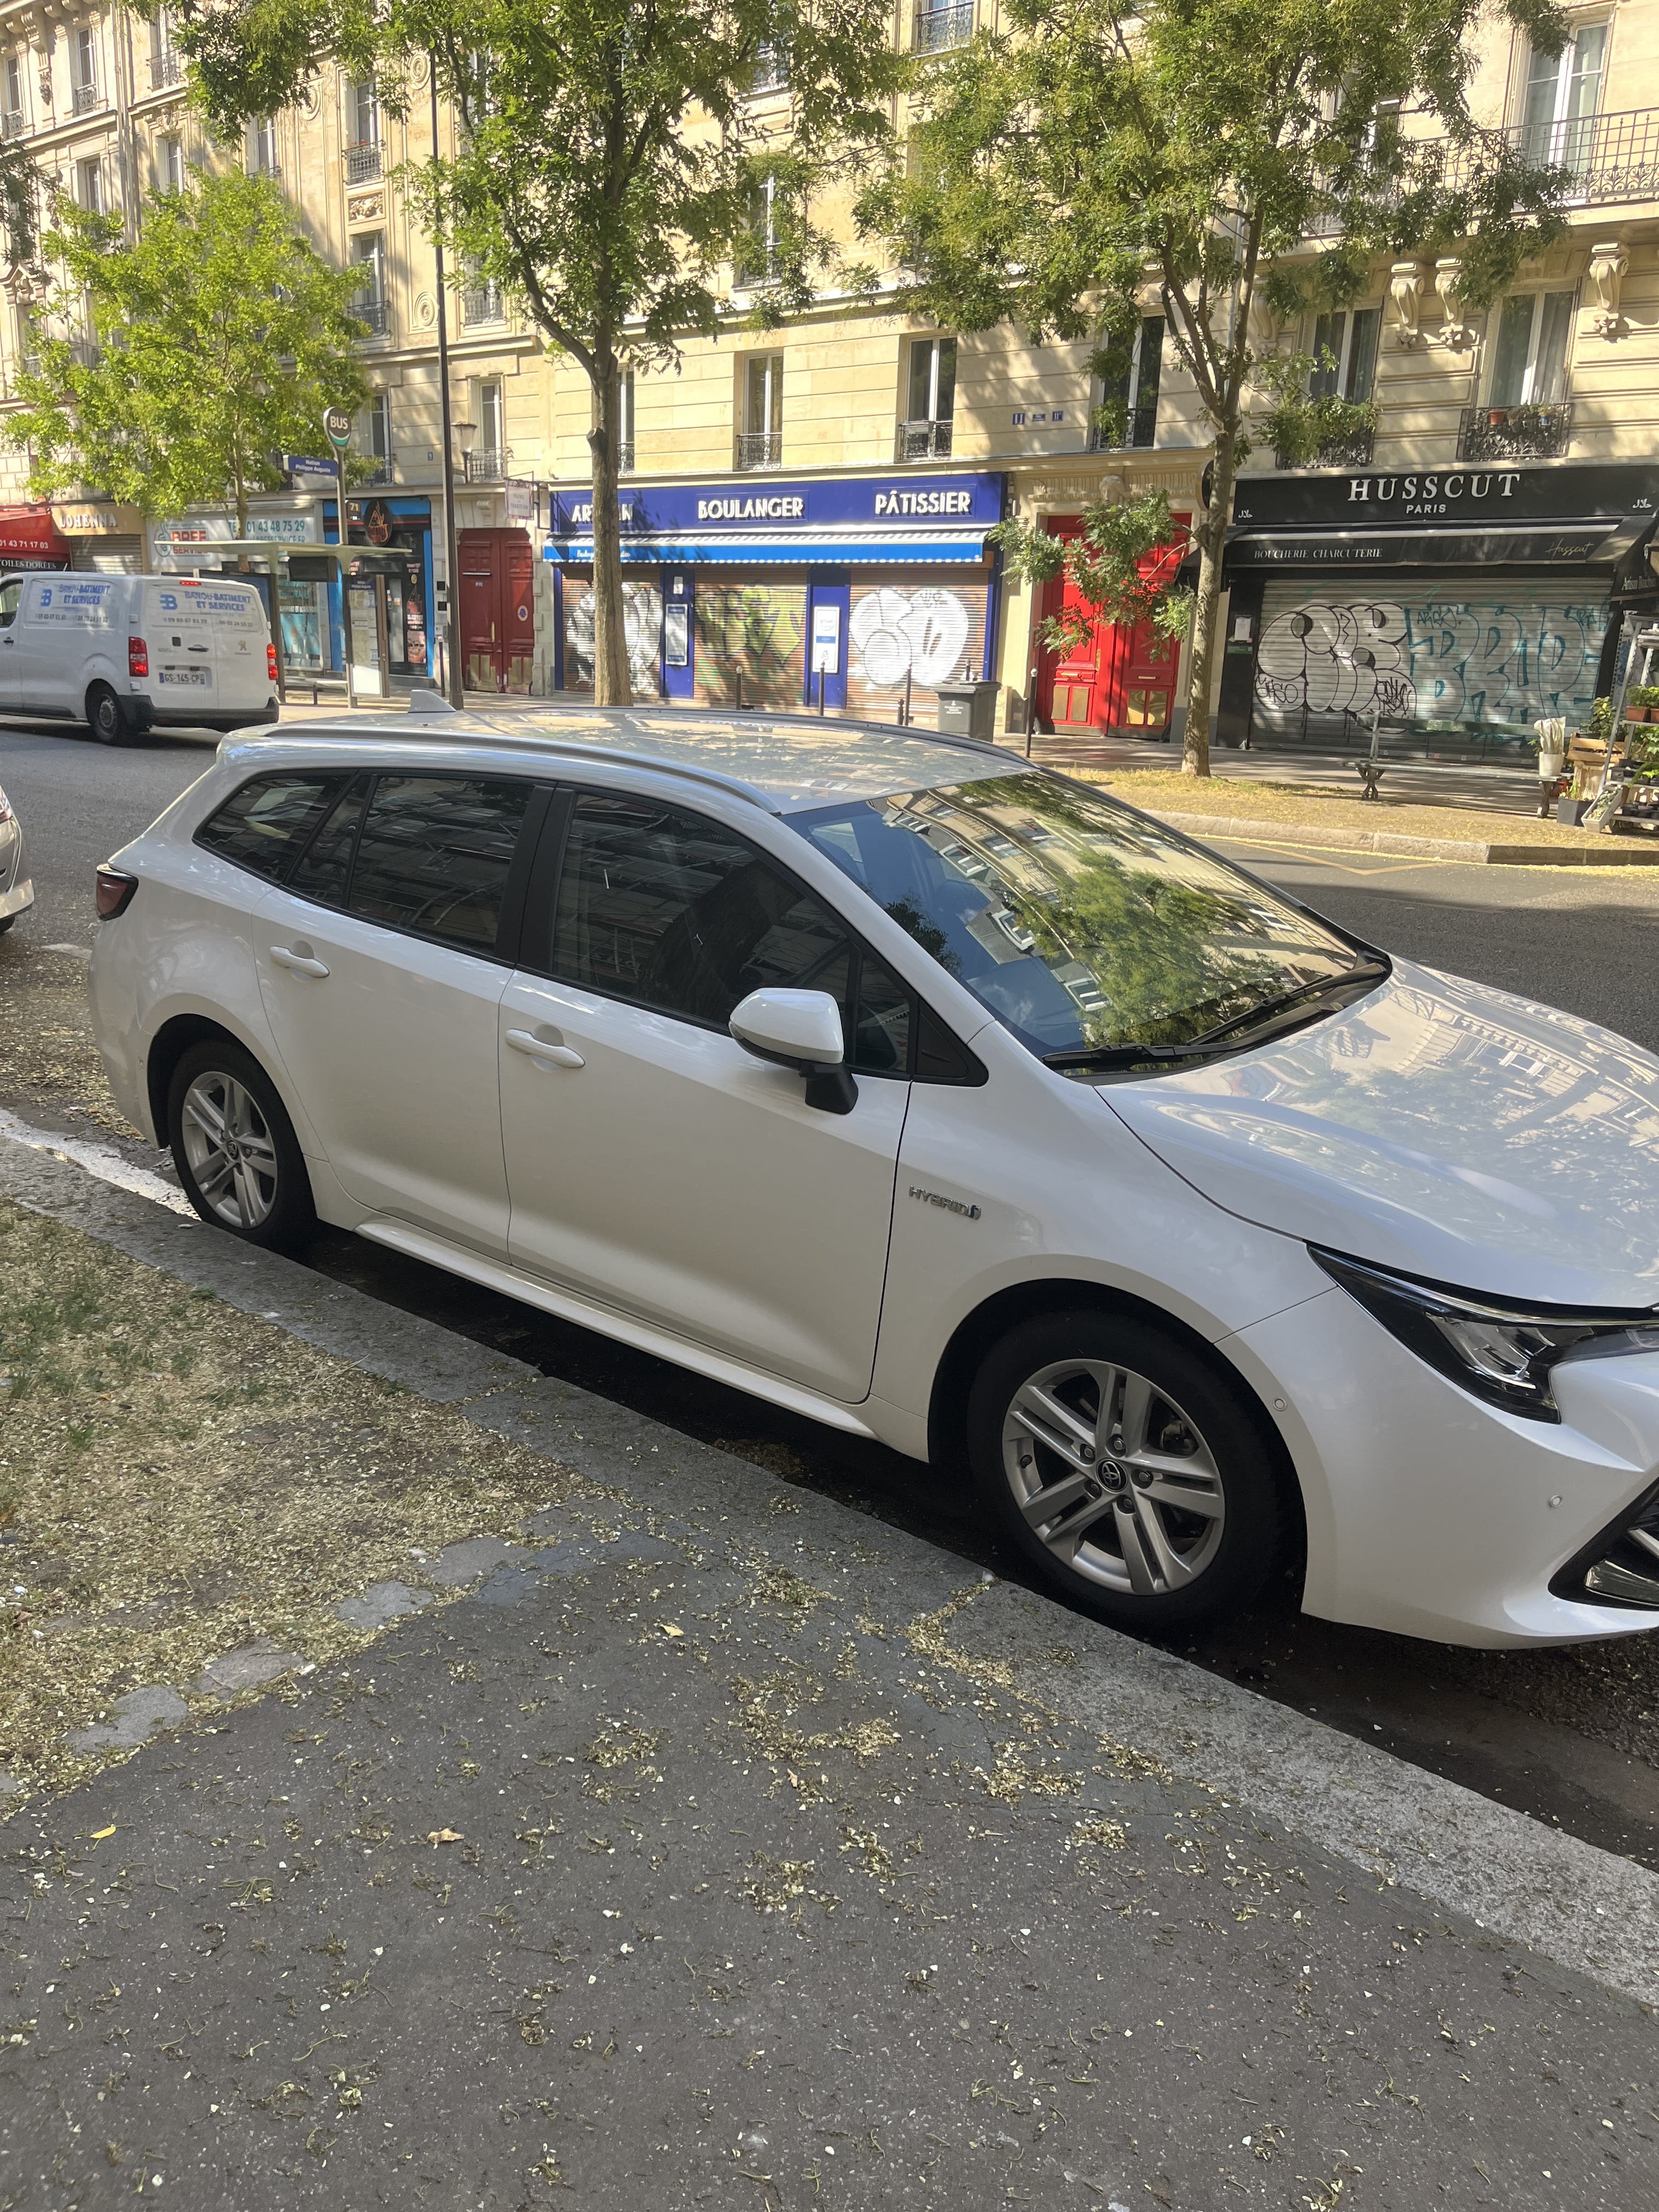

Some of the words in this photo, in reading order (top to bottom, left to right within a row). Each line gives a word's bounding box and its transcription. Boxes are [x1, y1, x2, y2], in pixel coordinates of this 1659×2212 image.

[330, 416, 348, 430] BUS
[1347, 473, 1520, 501] HUSSCUT
[349, 503, 358, 511] 71
[698, 497, 804, 519] BOULANGER
[875, 490, 971, 515] PÂTISSIER
[1406, 504, 1447, 514] PARIS
[247, 521, 255, 532] 01
[258, 521, 268, 532] 43
[270, 520, 280, 532] 48
[283, 520, 292, 532] 75
[294, 520, 305, 532] 29
[1255, 550, 1309, 558] BOUCHERIE
[64, 595, 71, 603] ET
[72, 596, 100, 605] SERVICES
[209, 602, 245, 611] SERVICES
[909, 1185, 969, 1216] HYBRID
